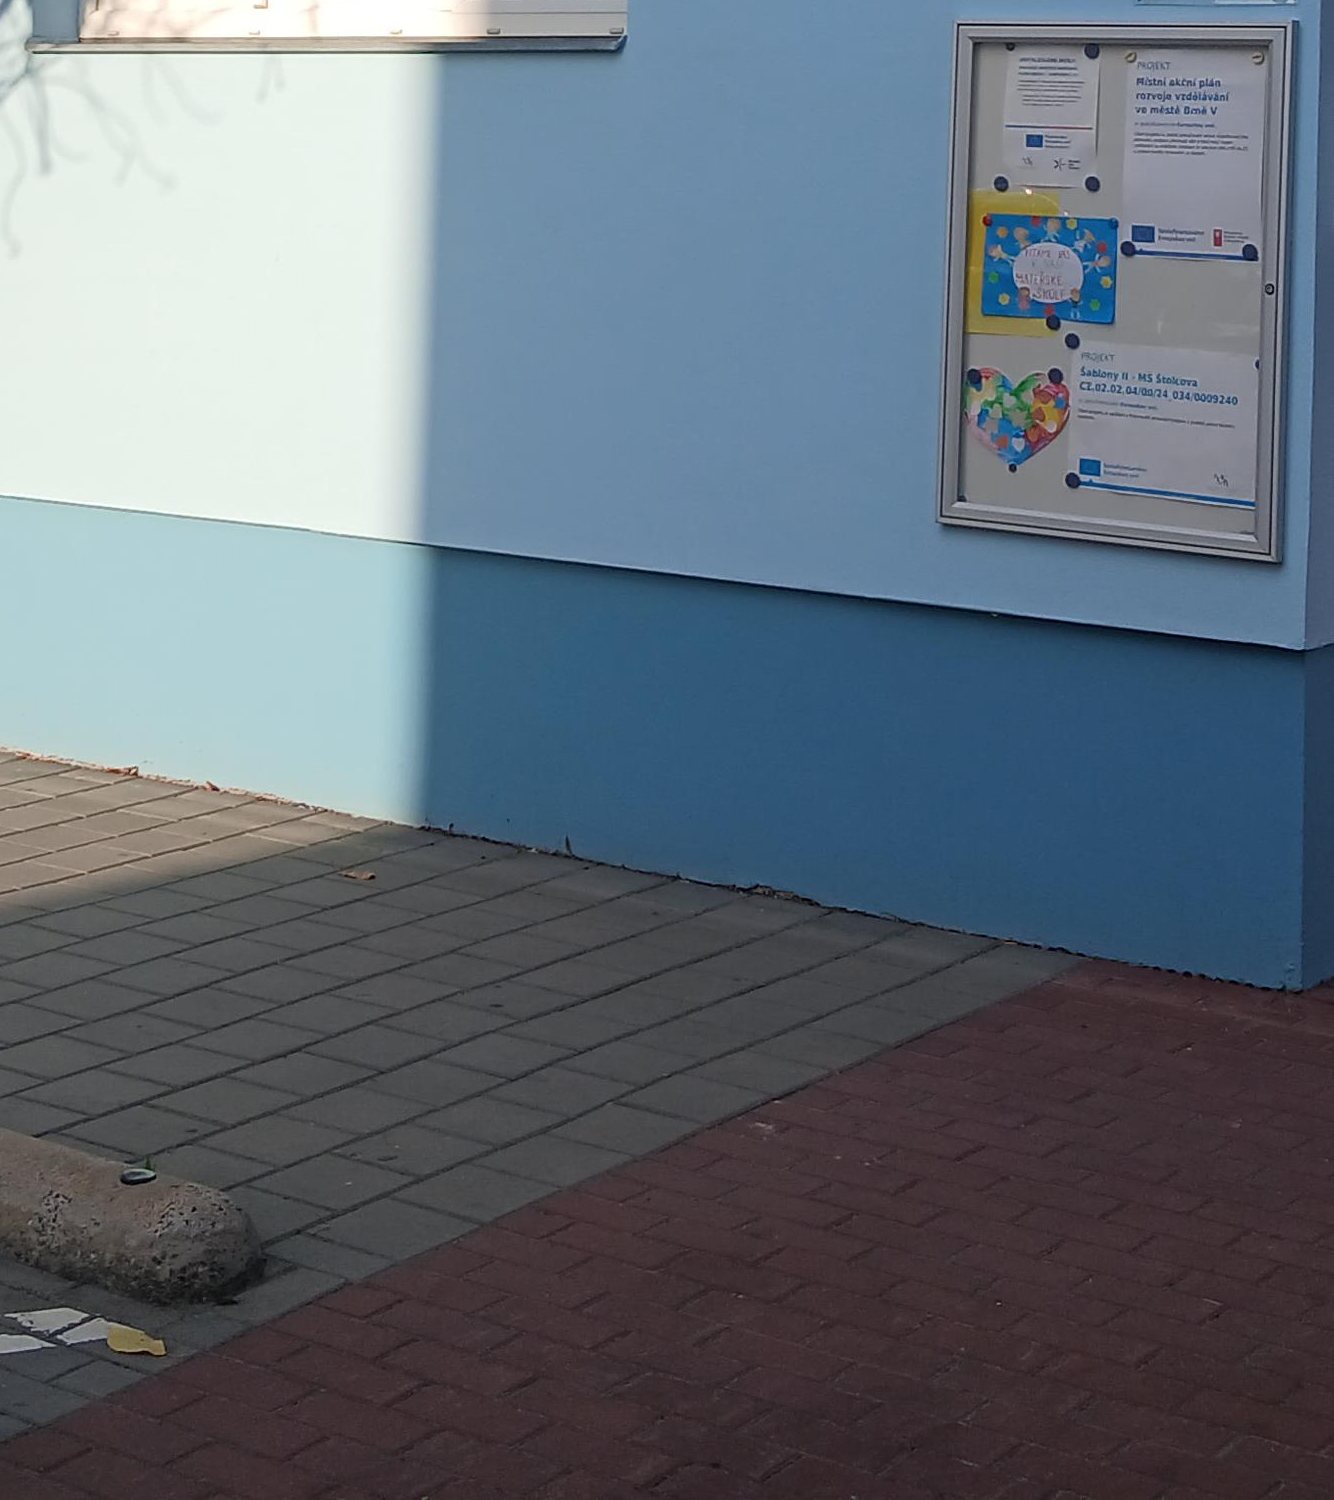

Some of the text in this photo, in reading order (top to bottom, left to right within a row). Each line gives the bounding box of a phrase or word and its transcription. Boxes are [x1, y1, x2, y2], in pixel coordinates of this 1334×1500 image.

[1199, 78, 1222, 89] plán
[1210, 106, 1218, 115] V
[1080, 367, 1118, 381] Šablony
[1156, 373, 1198, 387] Štolcova
